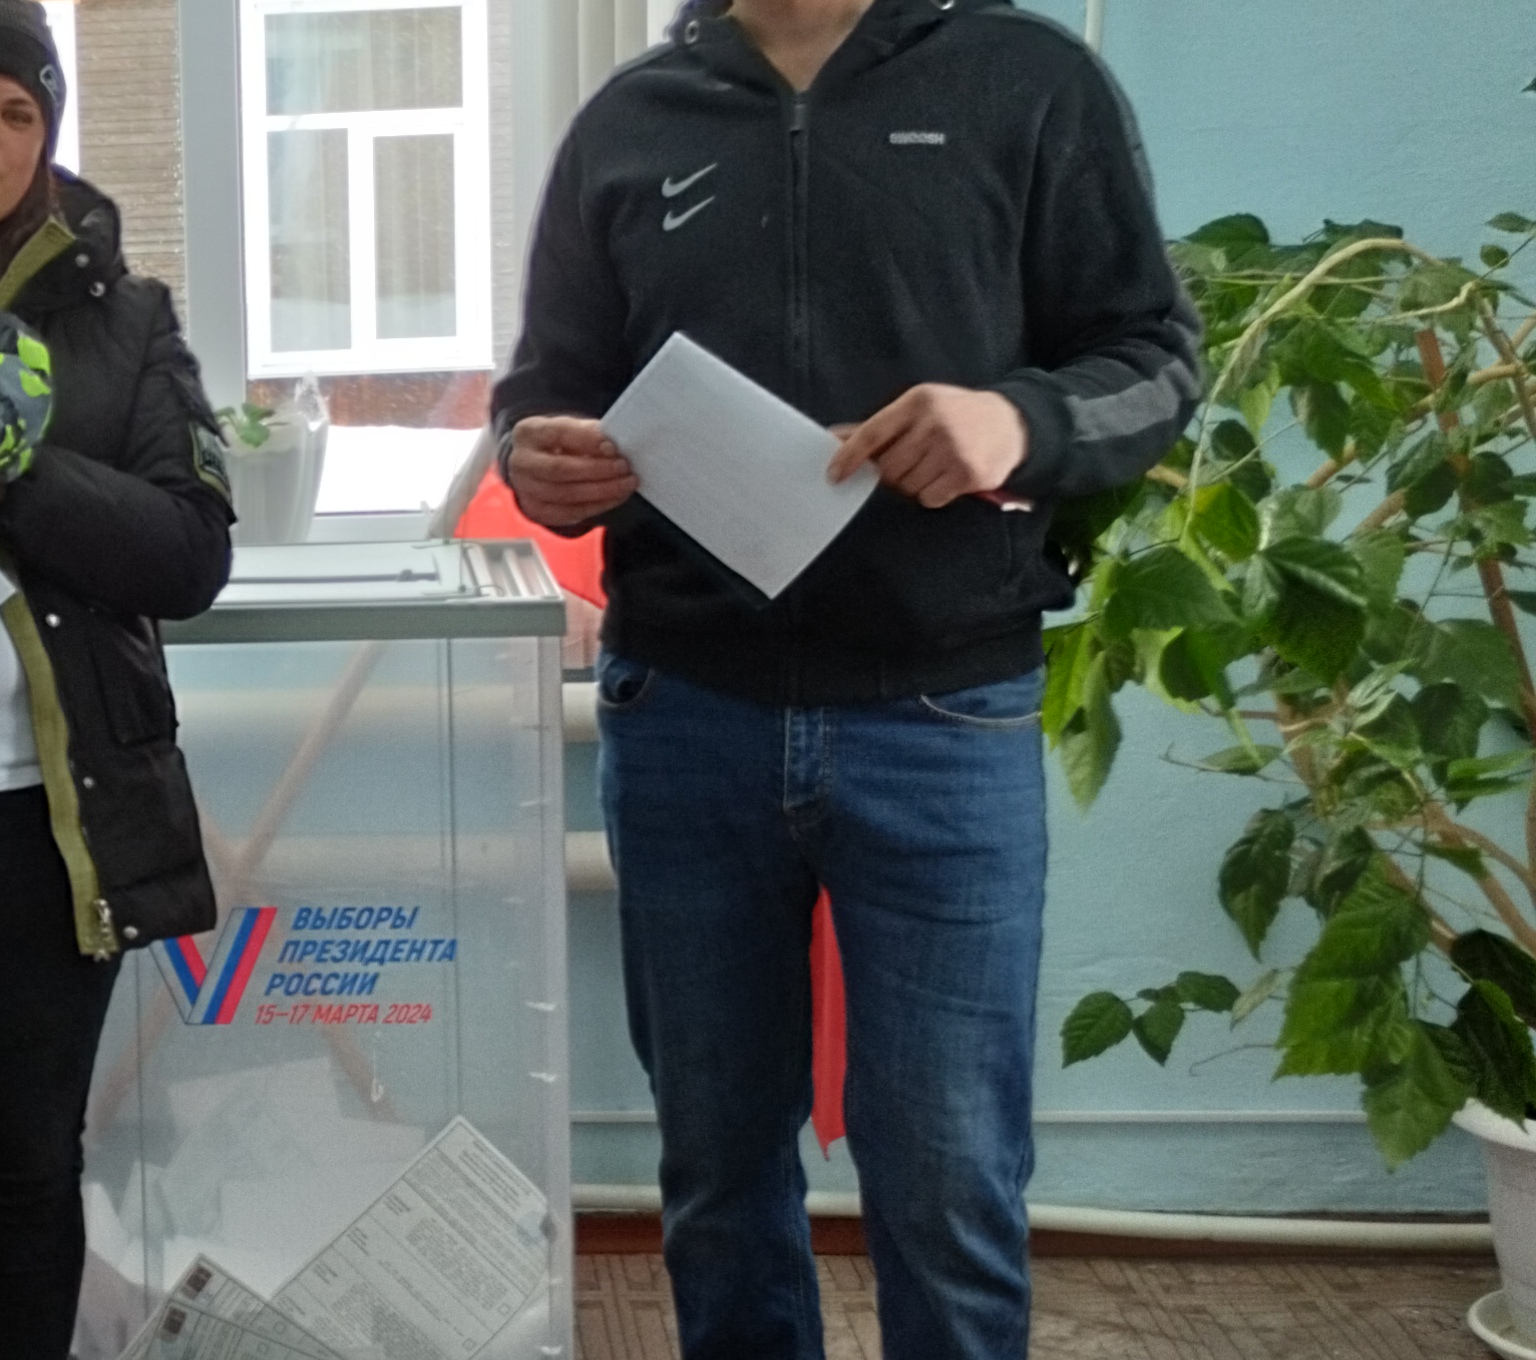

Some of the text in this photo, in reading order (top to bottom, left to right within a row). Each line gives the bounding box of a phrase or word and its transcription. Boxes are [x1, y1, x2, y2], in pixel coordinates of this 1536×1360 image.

[889, 131, 945, 145] SWOOSH
[291, 905, 420, 931] ВЫБОРЫ
[277, 938, 458, 966] ПРЕЗИДЕНТА
[263, 971, 380, 997] РОССИИ
[310, 1003, 380, 1025] МАРТА
[381, 1003, 433, 1025] 2024
